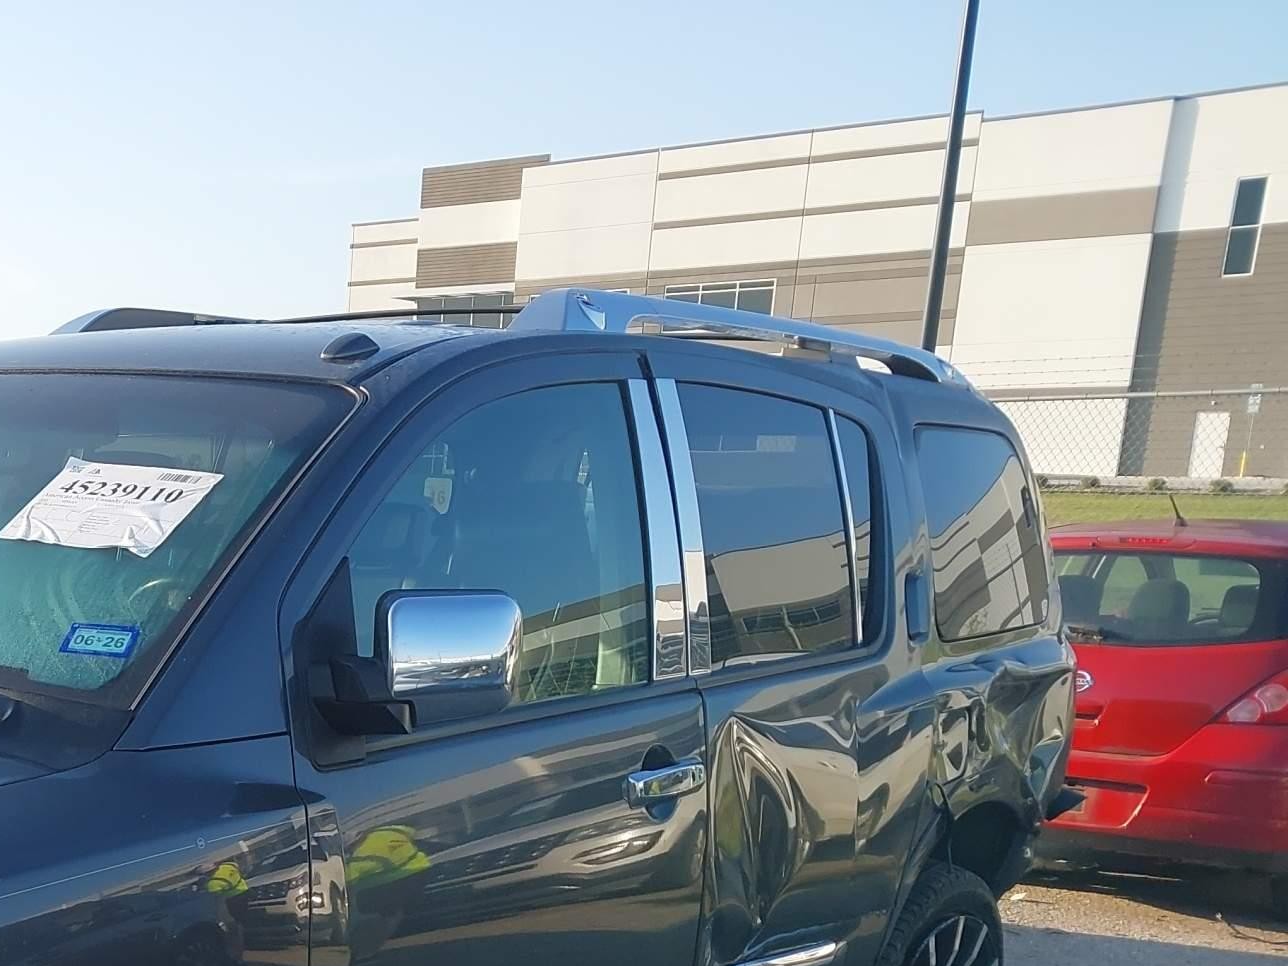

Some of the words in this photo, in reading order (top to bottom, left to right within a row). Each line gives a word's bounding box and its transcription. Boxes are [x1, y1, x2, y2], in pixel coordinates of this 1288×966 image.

[59, 479, 185, 504] 45239110
[73, 634, 96, 646] 06
[101, 636, 127, 649] 26
